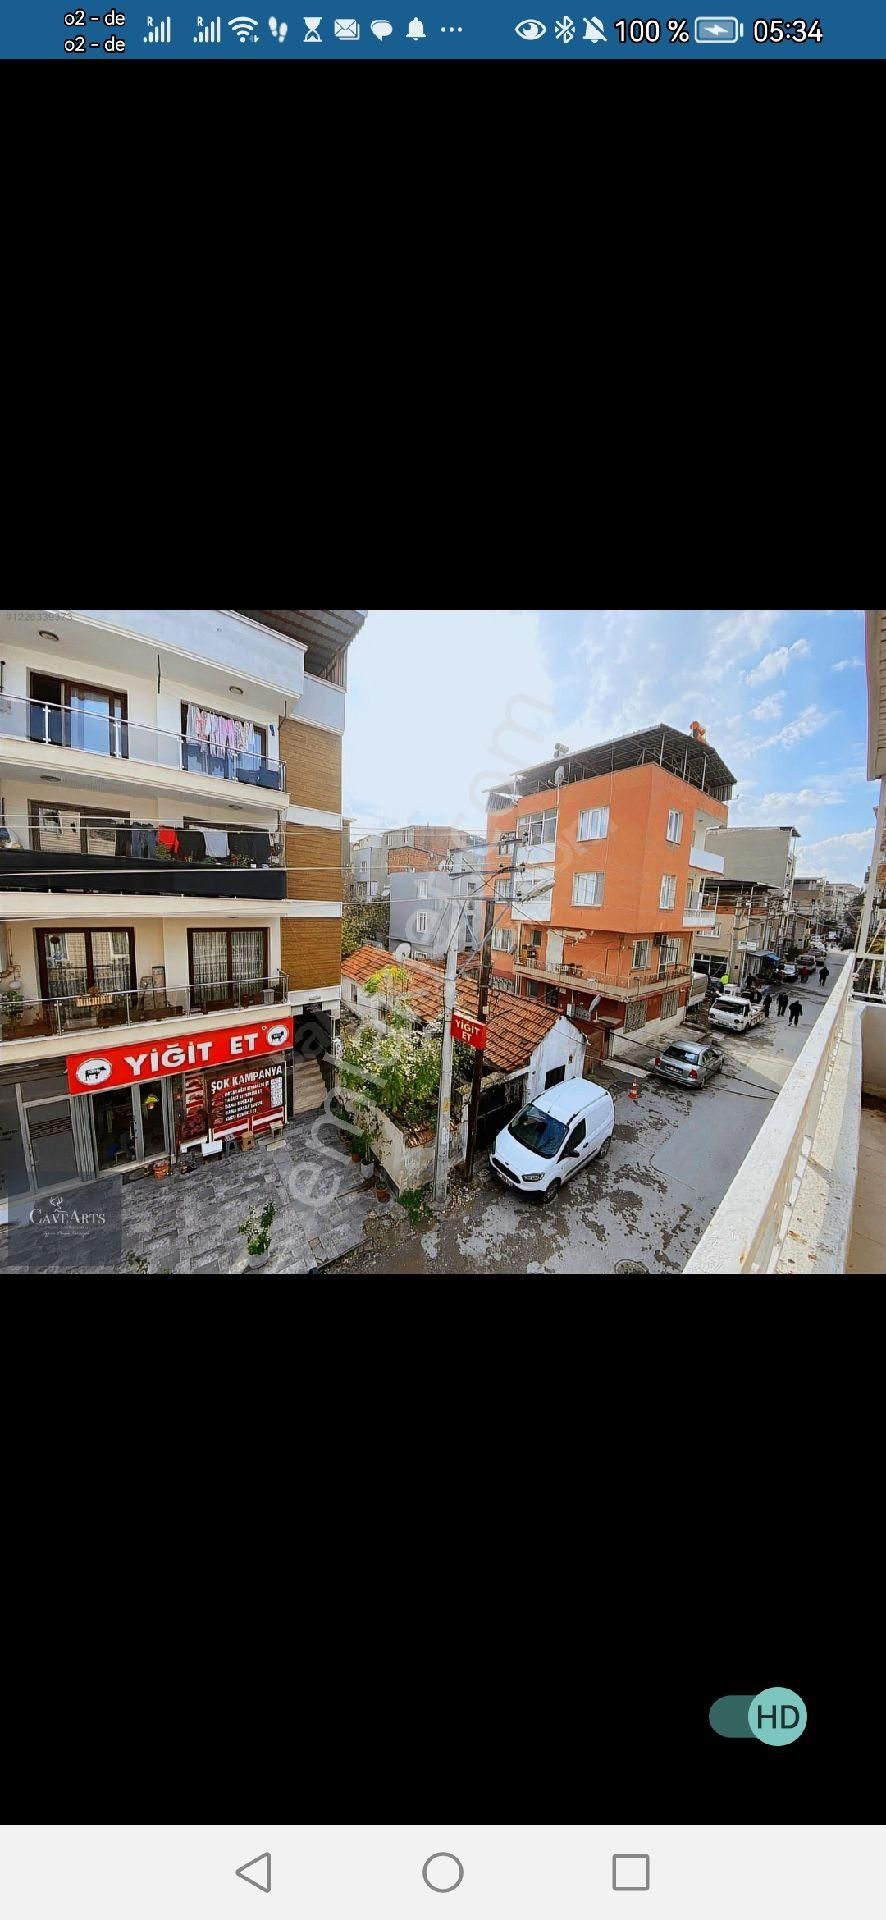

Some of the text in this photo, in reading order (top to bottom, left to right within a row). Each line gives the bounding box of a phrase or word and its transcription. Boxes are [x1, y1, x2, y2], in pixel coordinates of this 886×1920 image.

[64, 10, 85, 26] o2
[104, 9, 126, 26] de
[615, 20, 690, 43] 100 %
[754, 20, 823, 42] 05:34
[64, 36, 85, 52] o2
[104, 35, 126, 52] de
[462, 1031, 472, 1042] ET
[125, 1033, 259, 1076] YİĞİT ET
[211, 1078, 230, 1095] ŞOK
[232, 1065, 283, 1087] KAMPANYA
[757, 1704, 800, 1729] HD
